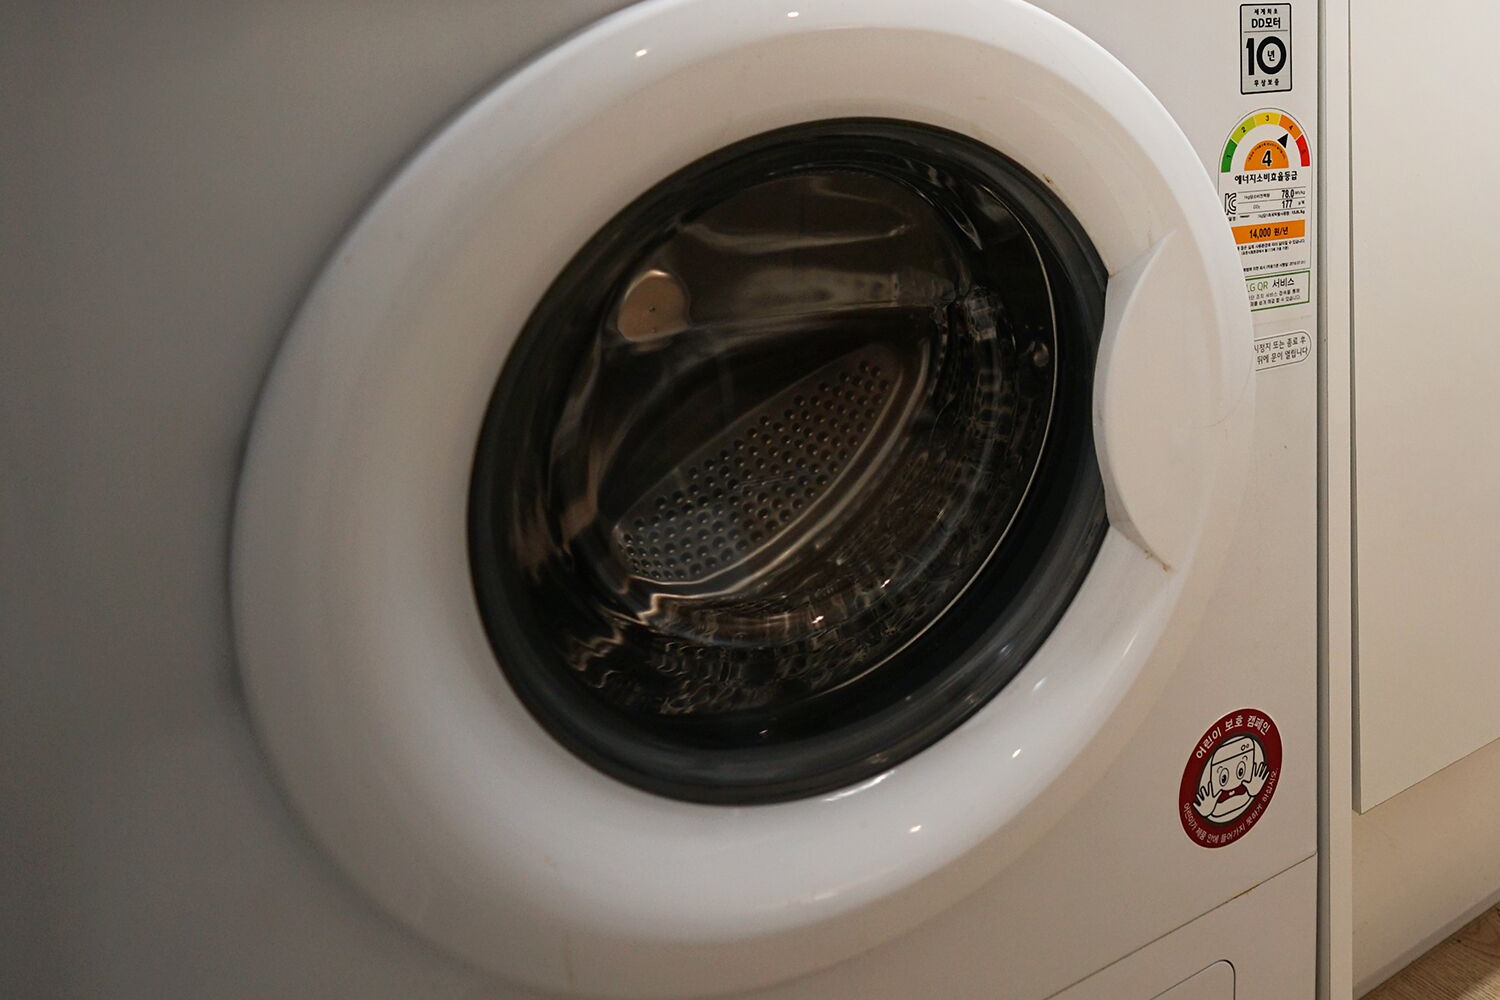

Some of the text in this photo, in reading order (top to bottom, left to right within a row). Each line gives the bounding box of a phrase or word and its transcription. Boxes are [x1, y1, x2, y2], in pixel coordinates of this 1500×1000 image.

[1251, 17, 1281, 29] DD모터
[1246, 36, 1287, 76] 10
[1267, 49, 1275, 62] 년
[1262, 150, 1272, 167] 4
[1234, 170, 1298, 185] 에너지소비효율등급
[1281, 189, 1295, 199] 78.0
[1281, 199, 1293, 209] 177
[1249, 226, 1289, 240] 14,000 원/년
[1257, 280, 1269, 292] QR
[1272, 277, 1295, 288] 서비스
[1272, 340, 1285, 350] 또는
[1257, 354, 1269, 365] 뒤에
[1196, 714, 1271, 759] 어린이 보호 캠페인
